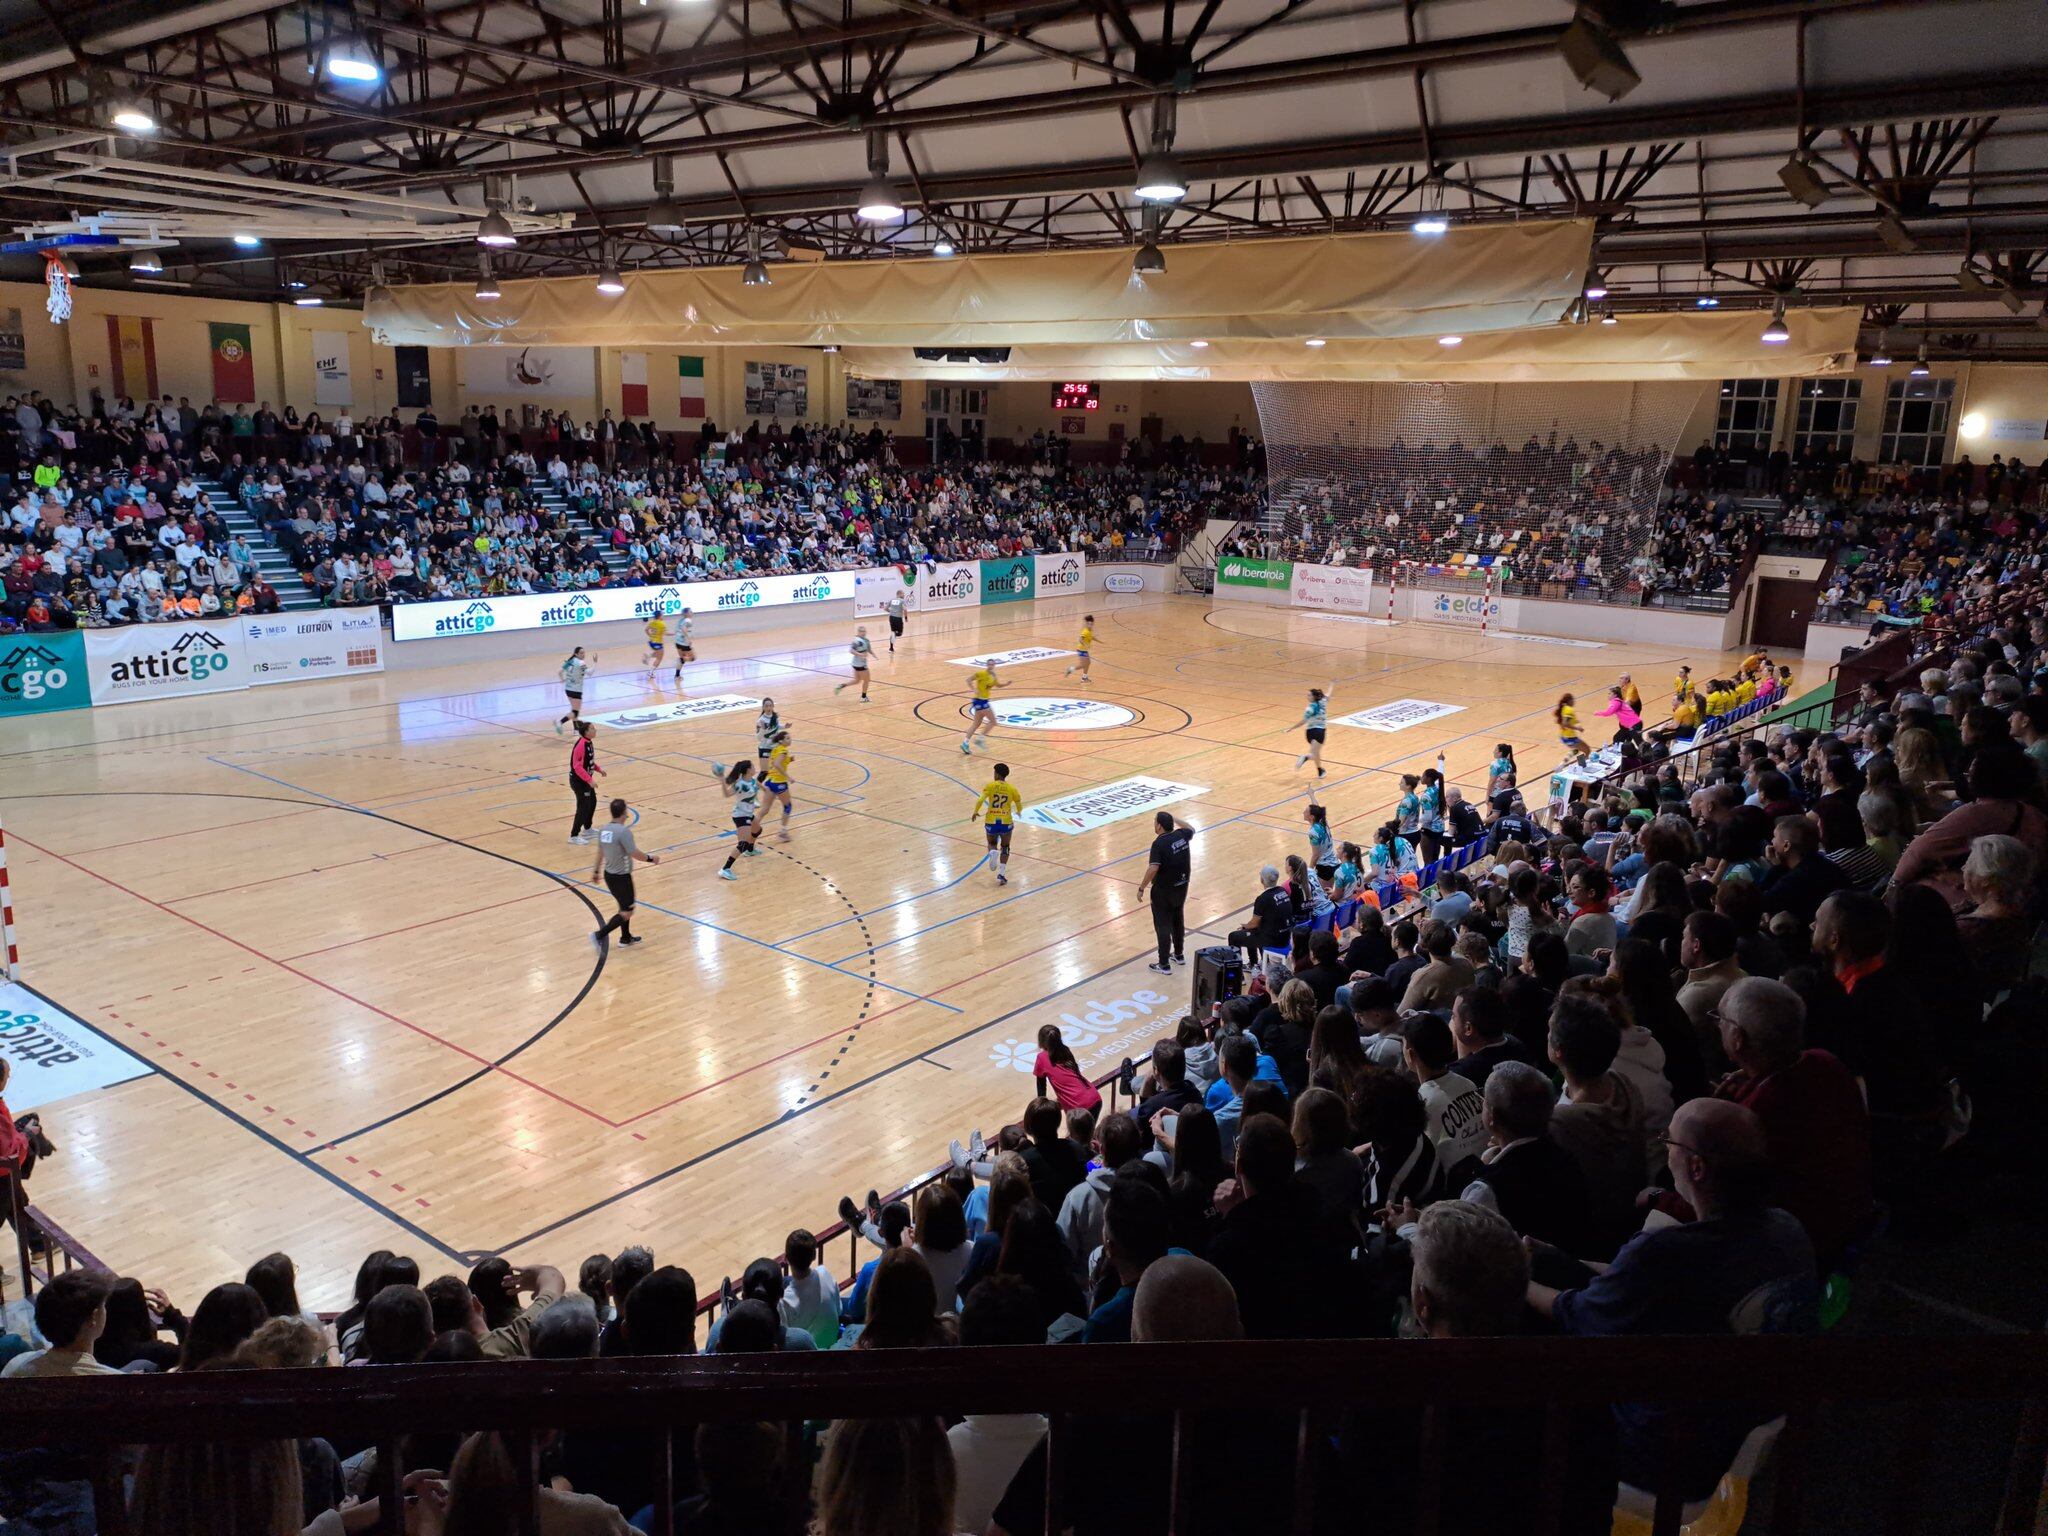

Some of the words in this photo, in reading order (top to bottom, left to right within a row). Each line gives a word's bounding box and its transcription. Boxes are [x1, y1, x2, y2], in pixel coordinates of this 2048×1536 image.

[1064, 384, 1087, 393] 25:56
[1056, 398, 1067, 408] 31
[1086, 400, 1097, 408] 20
[988, 571, 1029, 592] atticgo
[1041, 569, 1079, 586] atticgo
[1242, 567, 1285, 581] Iberdrola
[1307, 574, 1326, 583] ribera
[793, 584, 830, 599] atticgo
[929, 580, 974, 599] atticgo
[635, 597, 681, 614] atticgo
[718, 592, 760, 607] atticgo
[1305, 594, 1324, 603] ribera
[541, 605, 594, 622] atticgo
[297, 622, 332, 635] LEOTRON
[436, 613, 495, 632] atticgo
[111, 650, 229, 681] atticgo
[148, 678, 167, 686] YOUR
[1025, 701, 1097, 717] elche
[1060, 784, 1158, 815] COMUNITAT
[1086, 806, 1116, 817] DE
[1060, 989, 1169, 1048] elche
